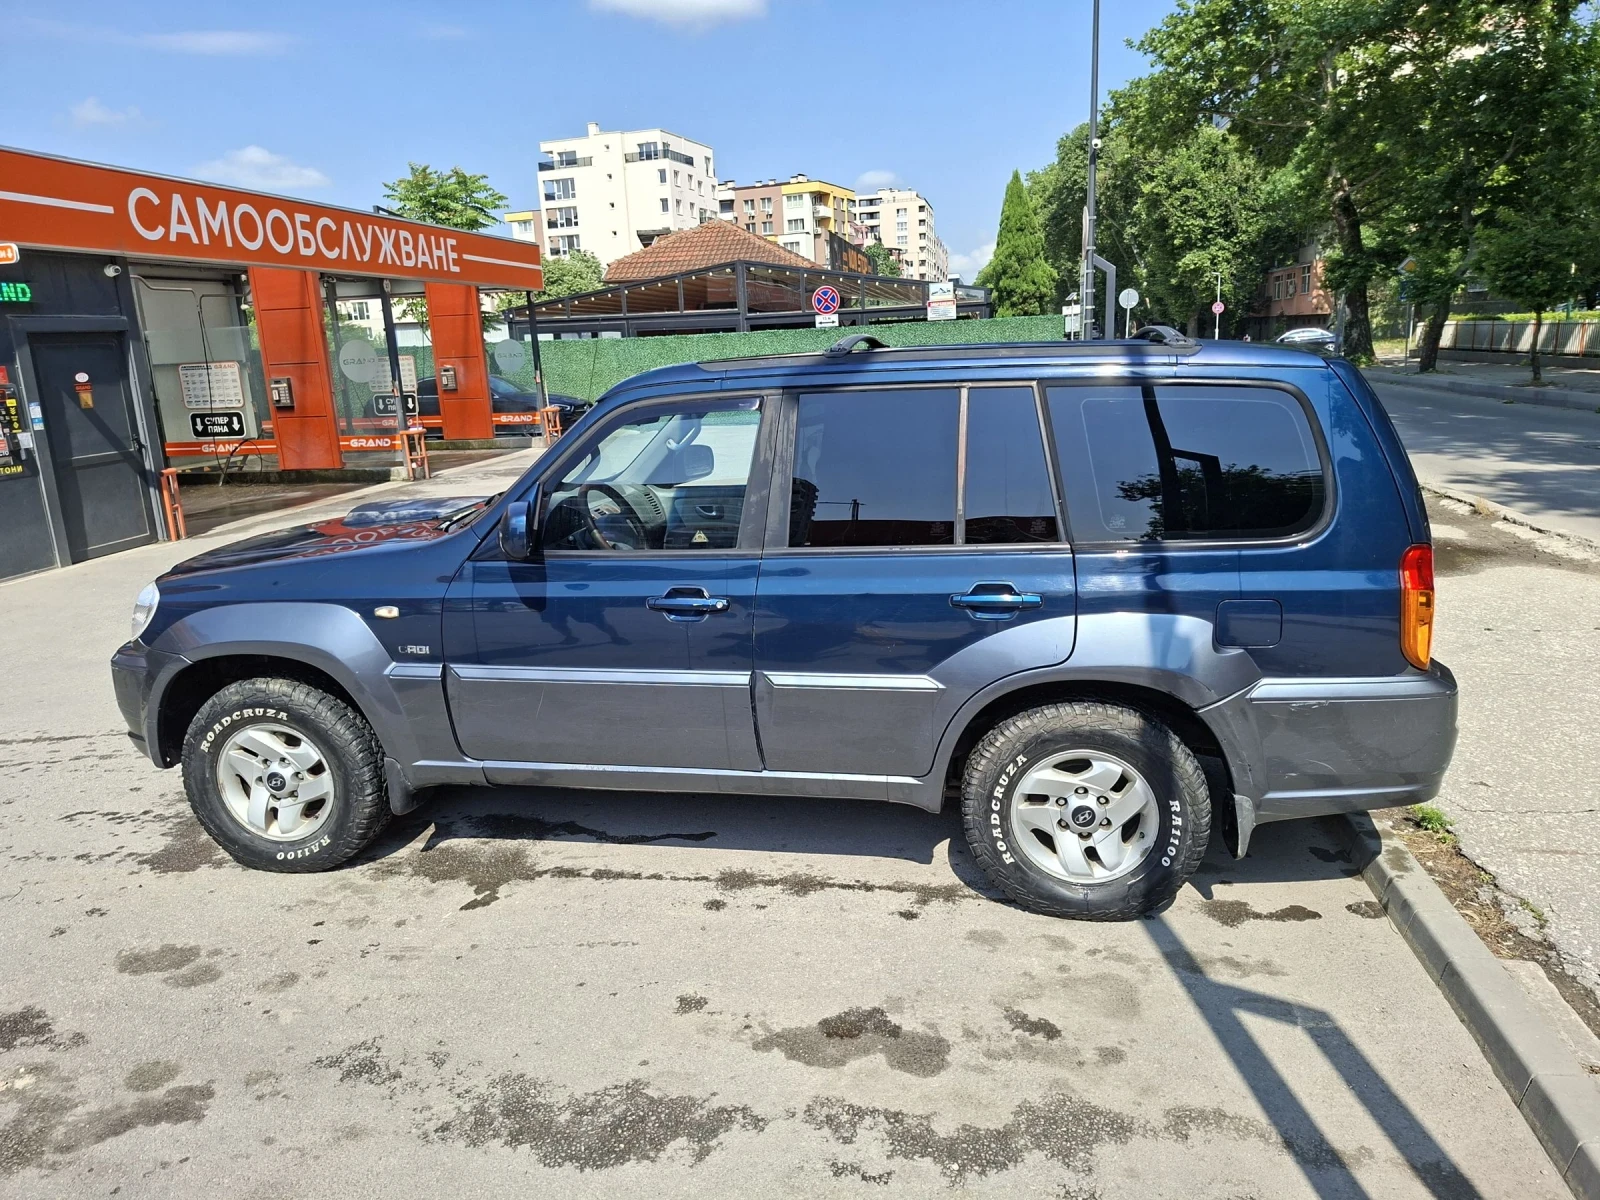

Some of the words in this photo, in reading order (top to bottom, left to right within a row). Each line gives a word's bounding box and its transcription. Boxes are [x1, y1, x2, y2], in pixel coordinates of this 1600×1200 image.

[128, 187, 461, 273] САМООБСЛУЖВАНЕ
[0, 282, 31, 302] ND
[343, 358, 375, 366] GRAND
[204, 416, 229, 425] СУПЕР
[208, 425, 229, 433] ПЯНА
[350, 438, 391, 447] GRAND
[200, 708, 289, 753] ROADCRUZA
[990, 753, 1029, 865] ROADCRUZA
[1161, 800, 1182, 867] RA1100
[276, 834, 331, 860] RA1100
